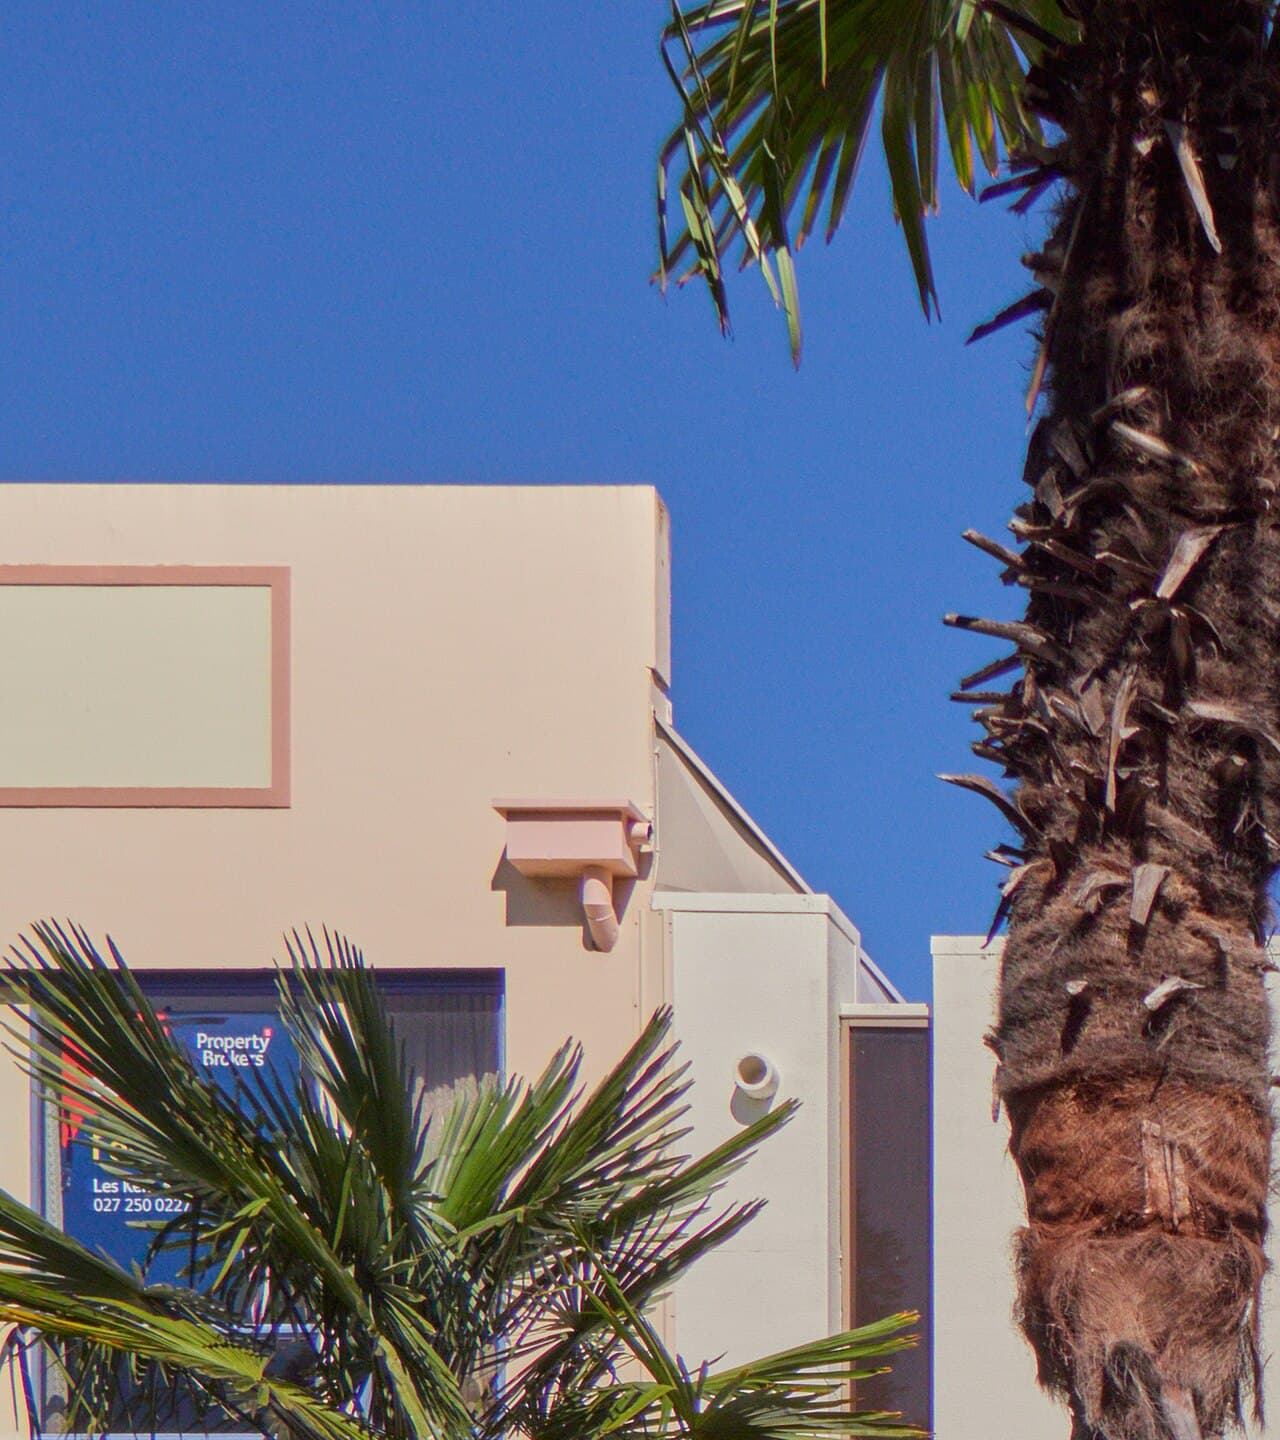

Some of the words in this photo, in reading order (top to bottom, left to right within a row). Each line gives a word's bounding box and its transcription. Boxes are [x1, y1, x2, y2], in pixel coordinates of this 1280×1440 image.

[196, 1032, 270, 1053] Property
[93, 1179, 119, 1193] Les
[94, 1199, 121, 1212] 027
[125, 1199, 152, 1212] 250
